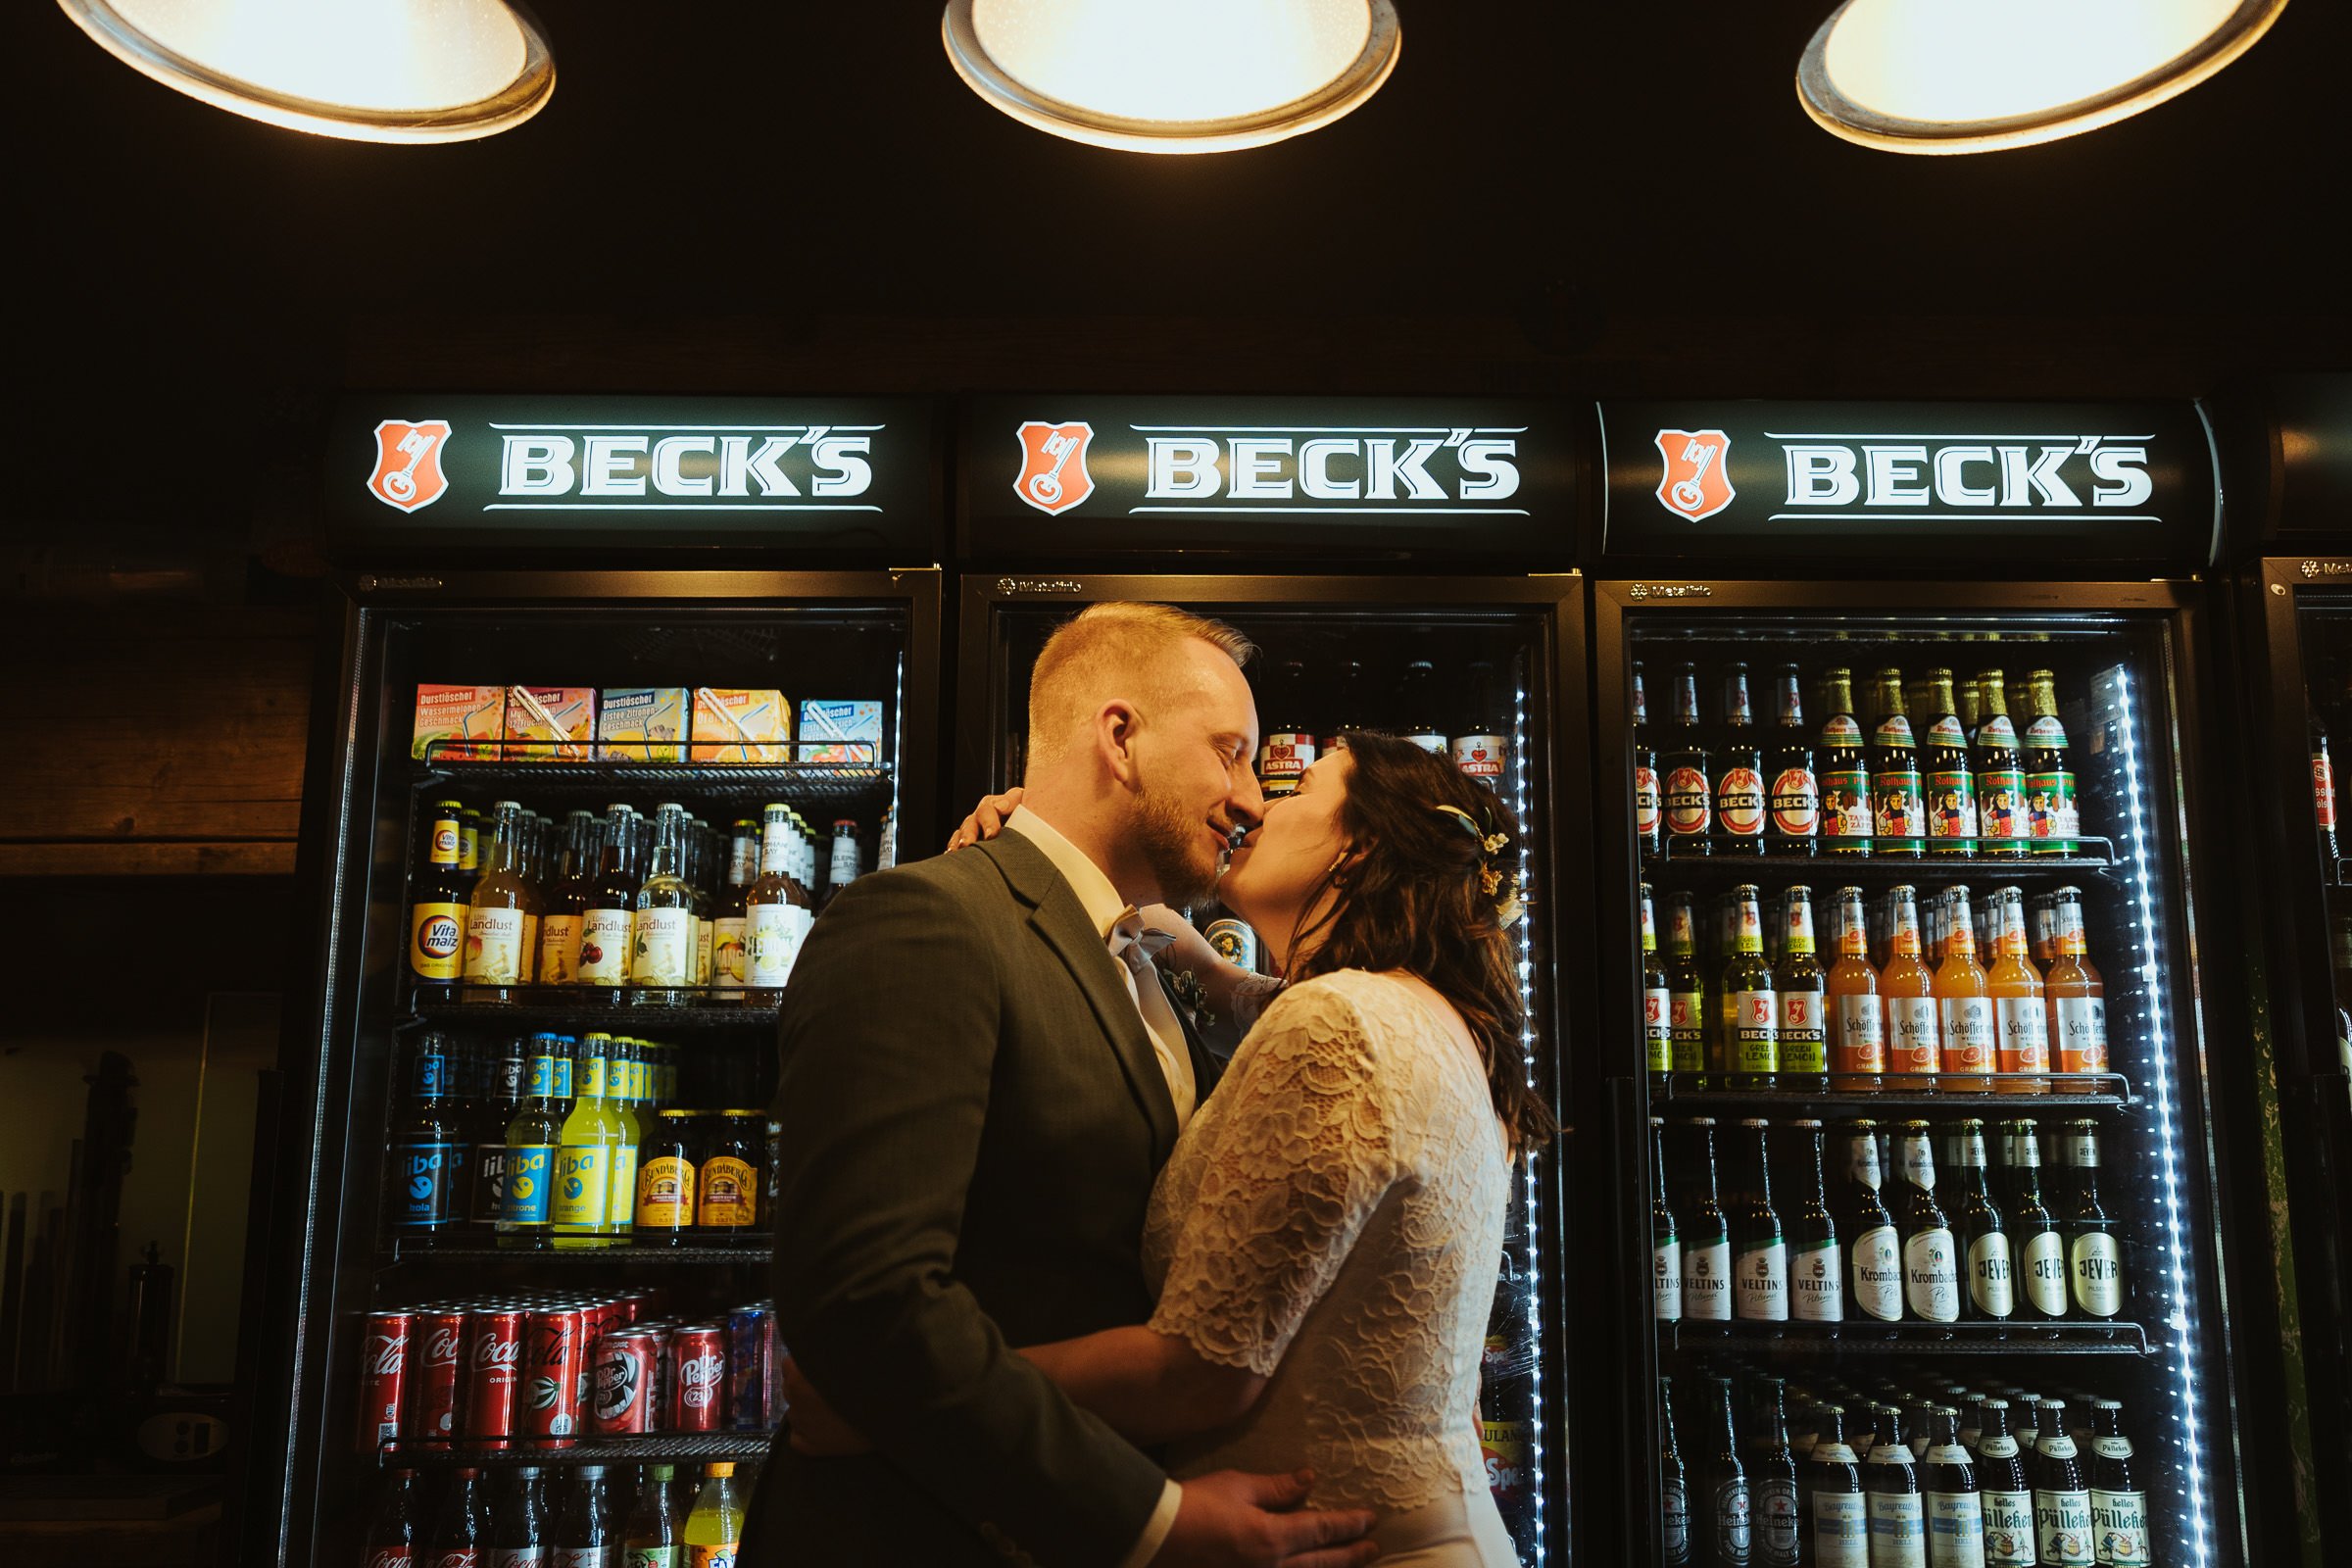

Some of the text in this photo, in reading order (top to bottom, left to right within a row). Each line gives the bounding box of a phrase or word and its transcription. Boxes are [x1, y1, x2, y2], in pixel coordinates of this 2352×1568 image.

[498, 424, 872, 497] BECK'S
[1144, 428, 1520, 500] BECK'S
[1782, 436, 2153, 507] BECK'S
[419, 691, 473, 706] Durstlöscher
[603, 694, 653, 710] Durstlöscher
[1265, 760, 1302, 770] ASTRA
[1720, 796, 1765, 808] BECK'S
[1773, 796, 1819, 808] BECK'S
[431, 924, 457, 937] Vita
[426, 936, 459, 948] malz
[2079, 1258, 2118, 1280] JEVER
[1654, 1278, 1680, 1290] LTINS
[1684, 1278, 1725, 1291] VELTINS
[1741, 1278, 1784, 1291] VELTINS
[1797, 1278, 1840, 1292] VELTINS
